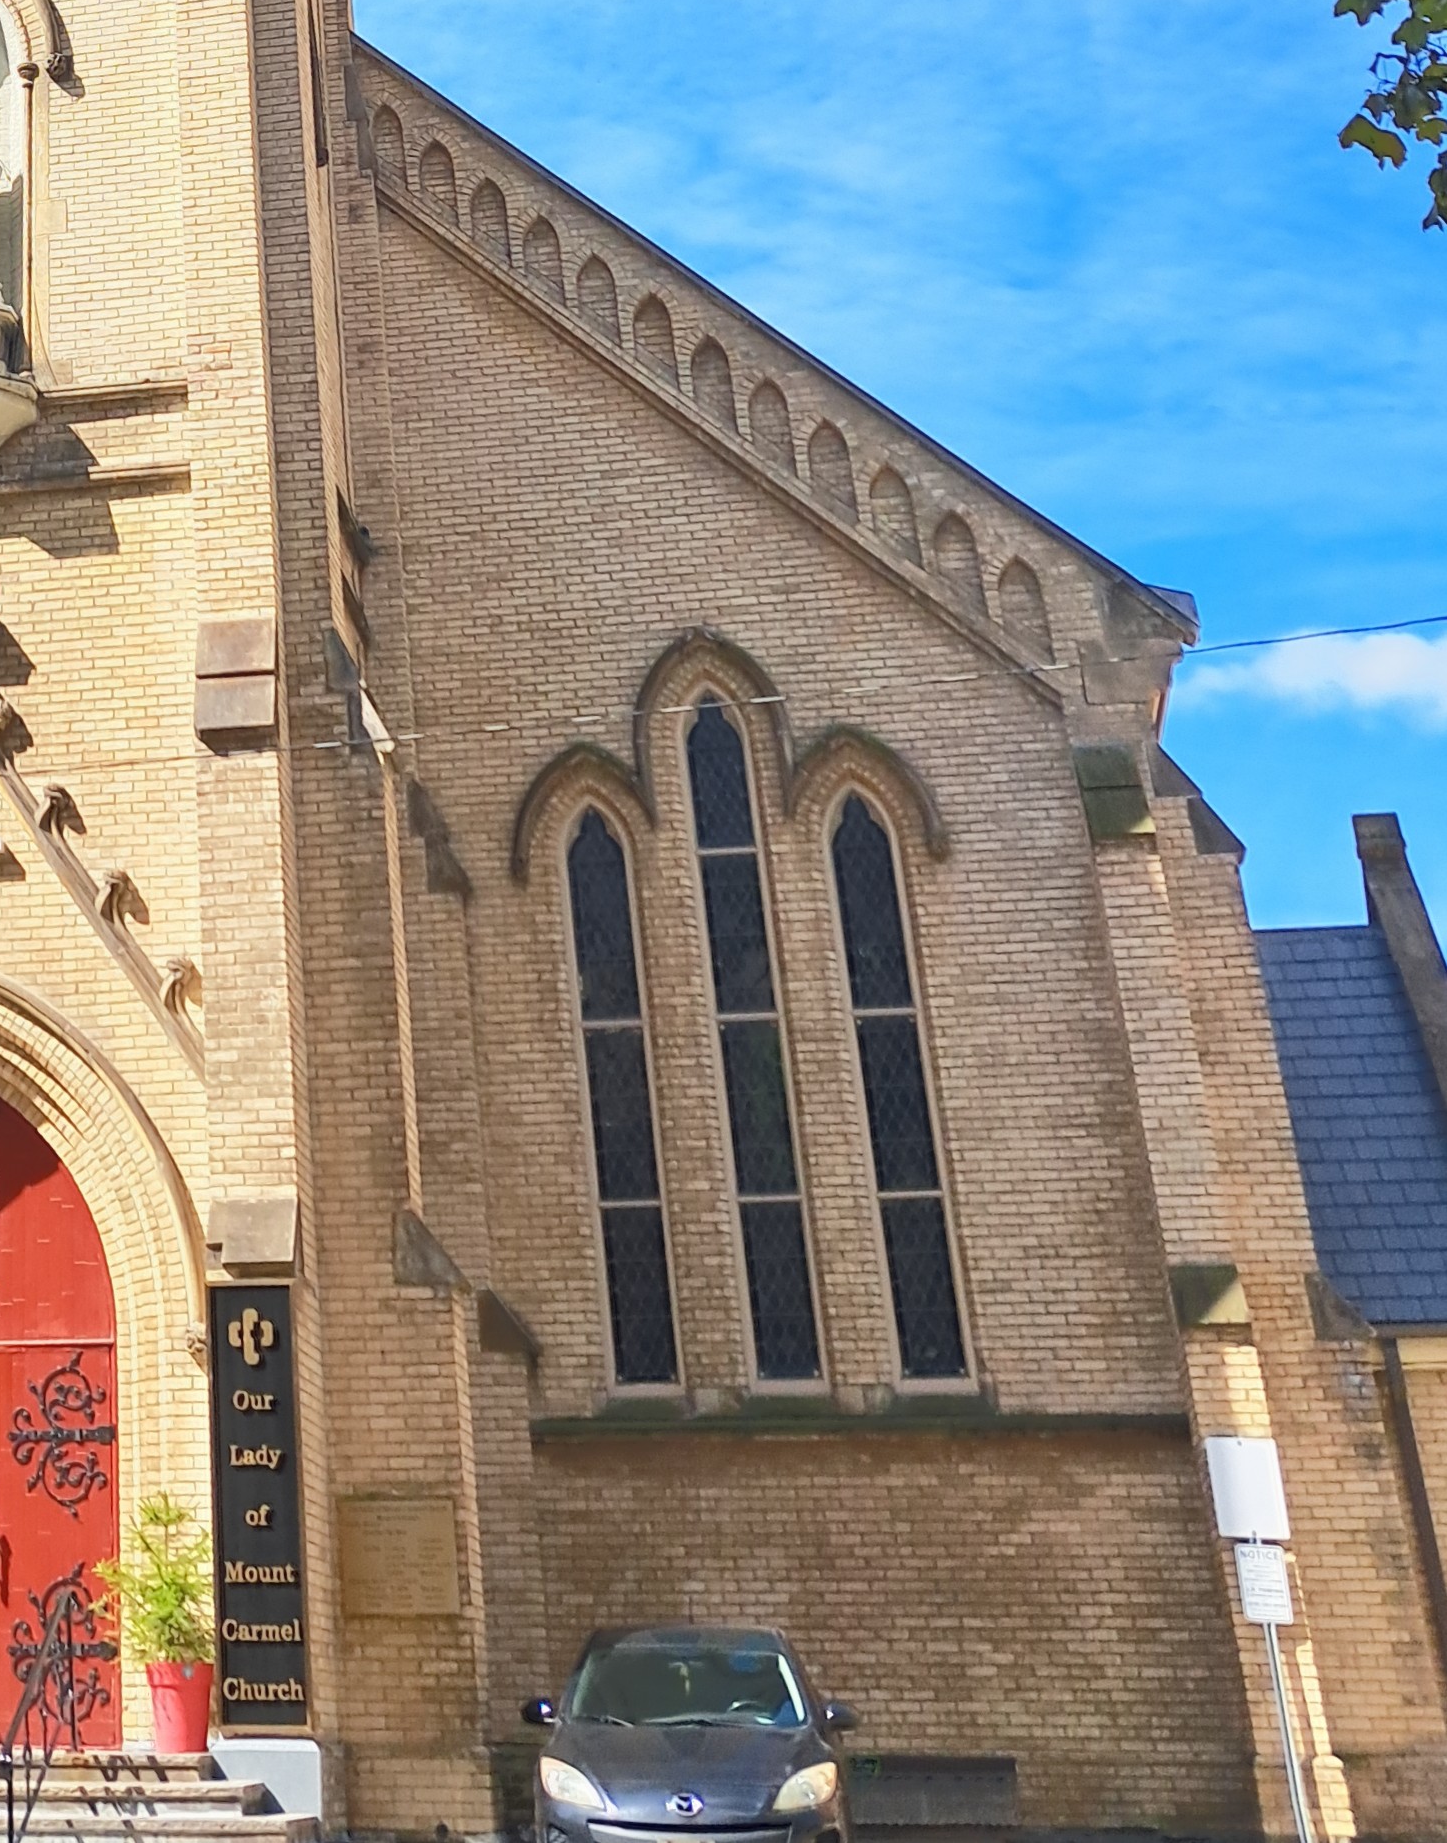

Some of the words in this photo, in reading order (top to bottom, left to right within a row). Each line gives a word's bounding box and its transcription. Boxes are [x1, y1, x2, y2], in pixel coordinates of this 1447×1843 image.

[233, 1390, 273, 1410] Our
[230, 1445, 281, 1468] Lady
[245, 1504, 270, 1526] of
[1240, 1549, 1279, 1561] NOTICE
[225, 1561, 295, 1583] Mount
[222, 1619, 302, 1642] Carmel
[223, 1678, 304, 1702] Church
